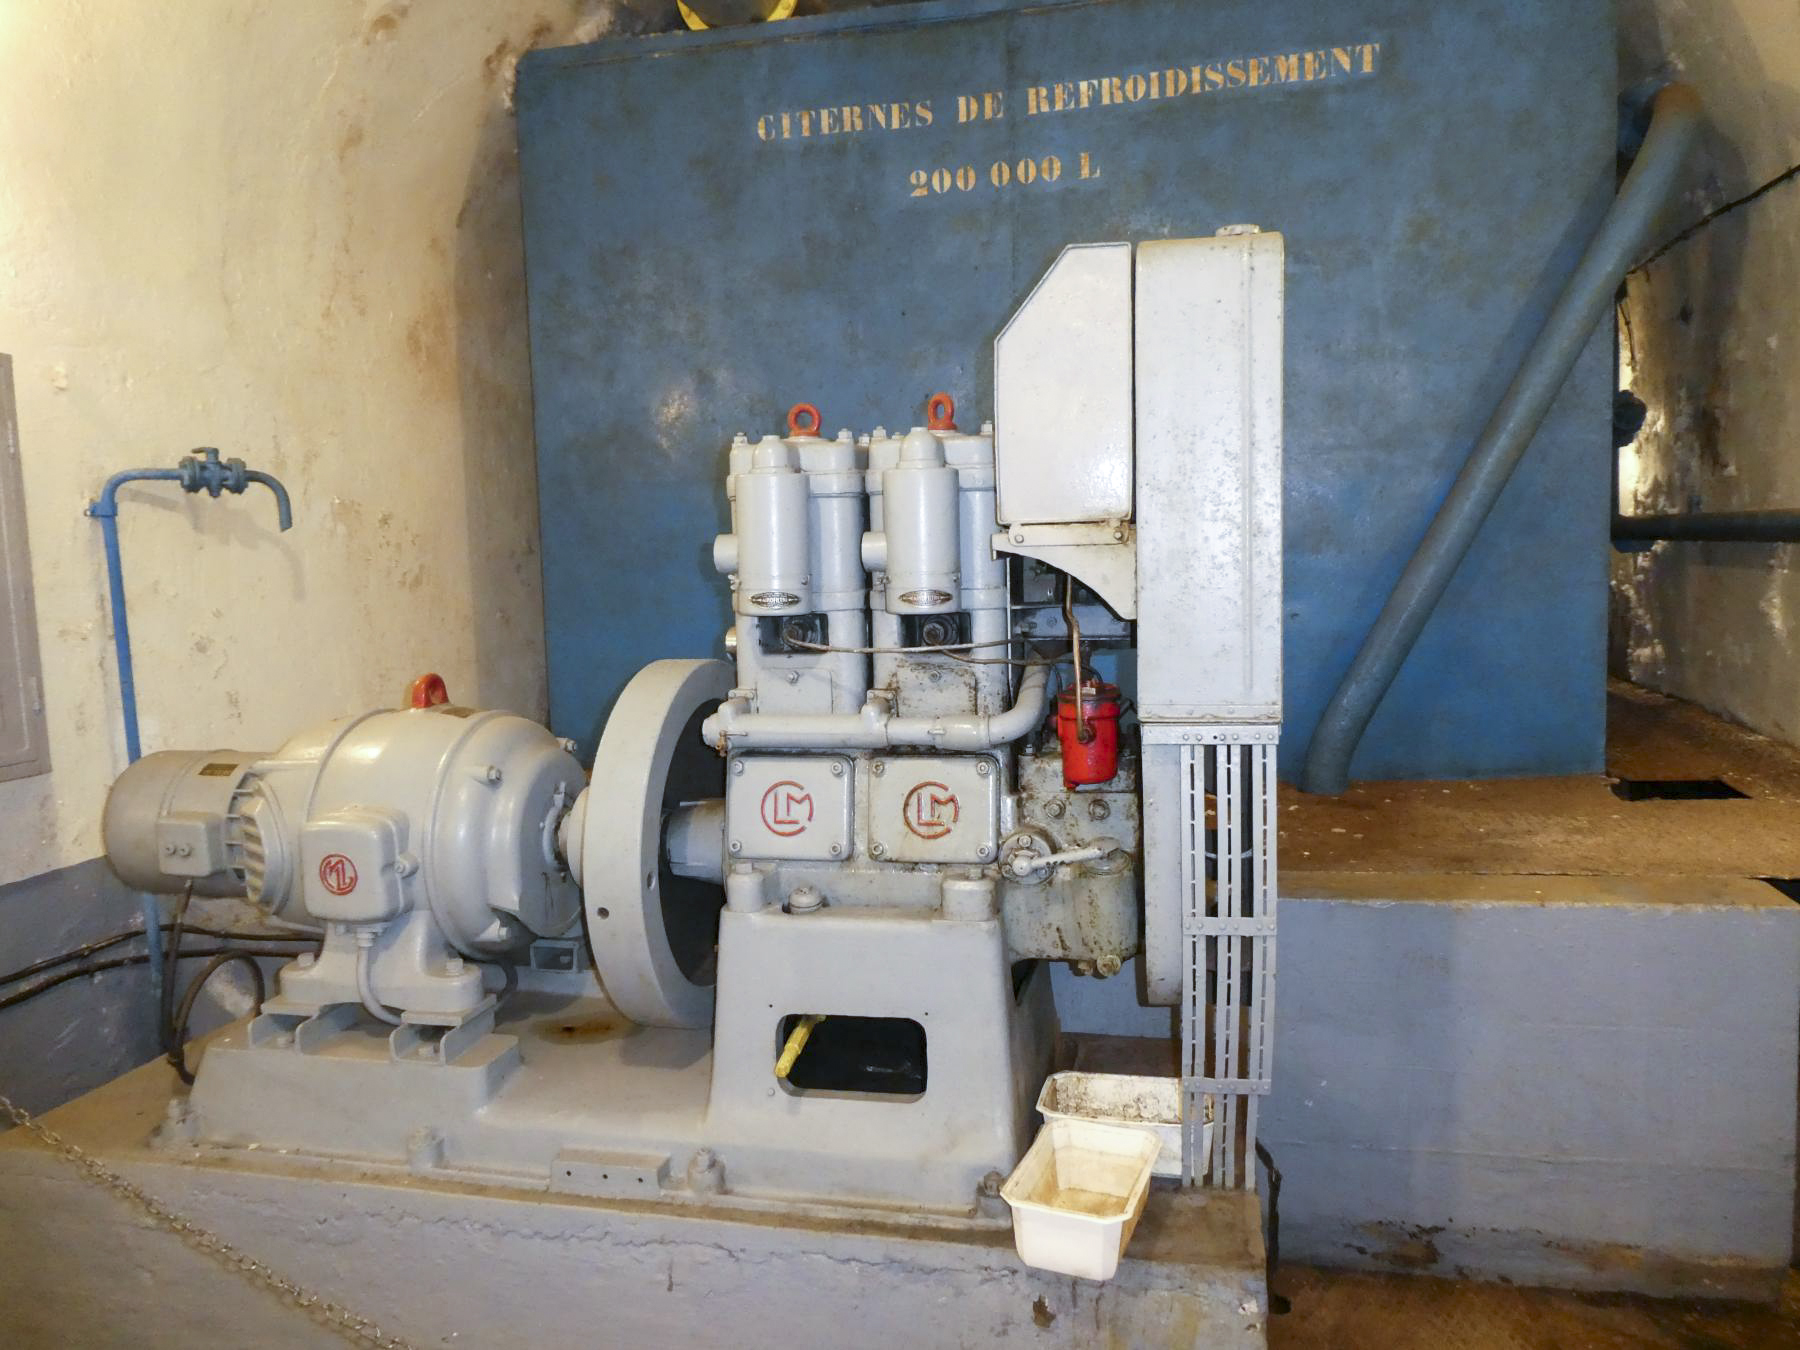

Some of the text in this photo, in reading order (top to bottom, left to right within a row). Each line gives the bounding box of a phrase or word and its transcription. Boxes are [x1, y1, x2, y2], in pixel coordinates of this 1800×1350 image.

[757, 43, 1380, 142] CITERNES DE REFROIDISSEMENT
[910, 152, 1100, 198] 200 000 L
